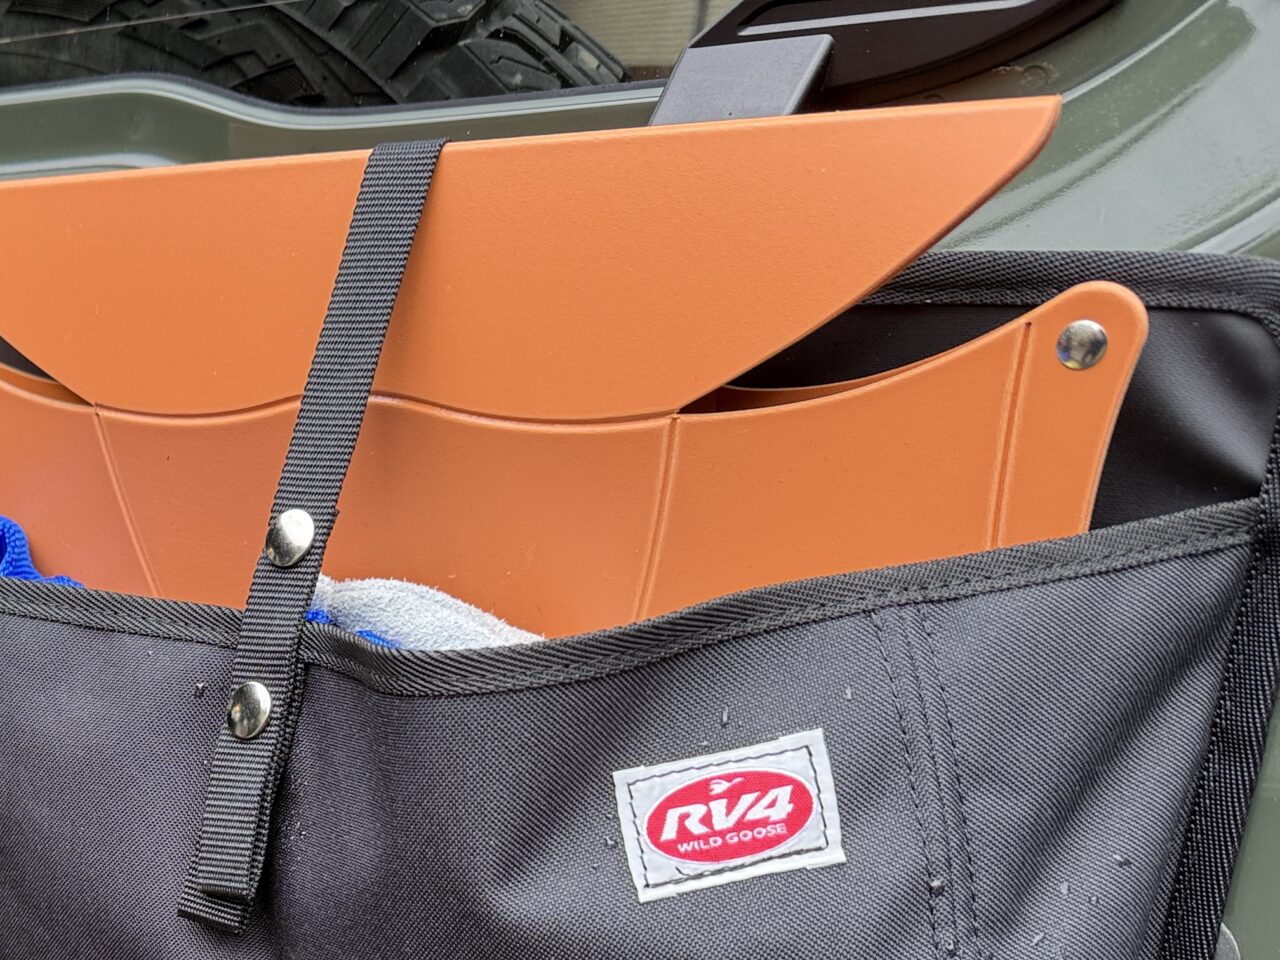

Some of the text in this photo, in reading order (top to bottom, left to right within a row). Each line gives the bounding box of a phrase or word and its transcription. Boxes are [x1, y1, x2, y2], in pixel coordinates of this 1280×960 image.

[660, 786, 794, 841] RV4
[677, 823, 786, 853] WILD GOOSE
